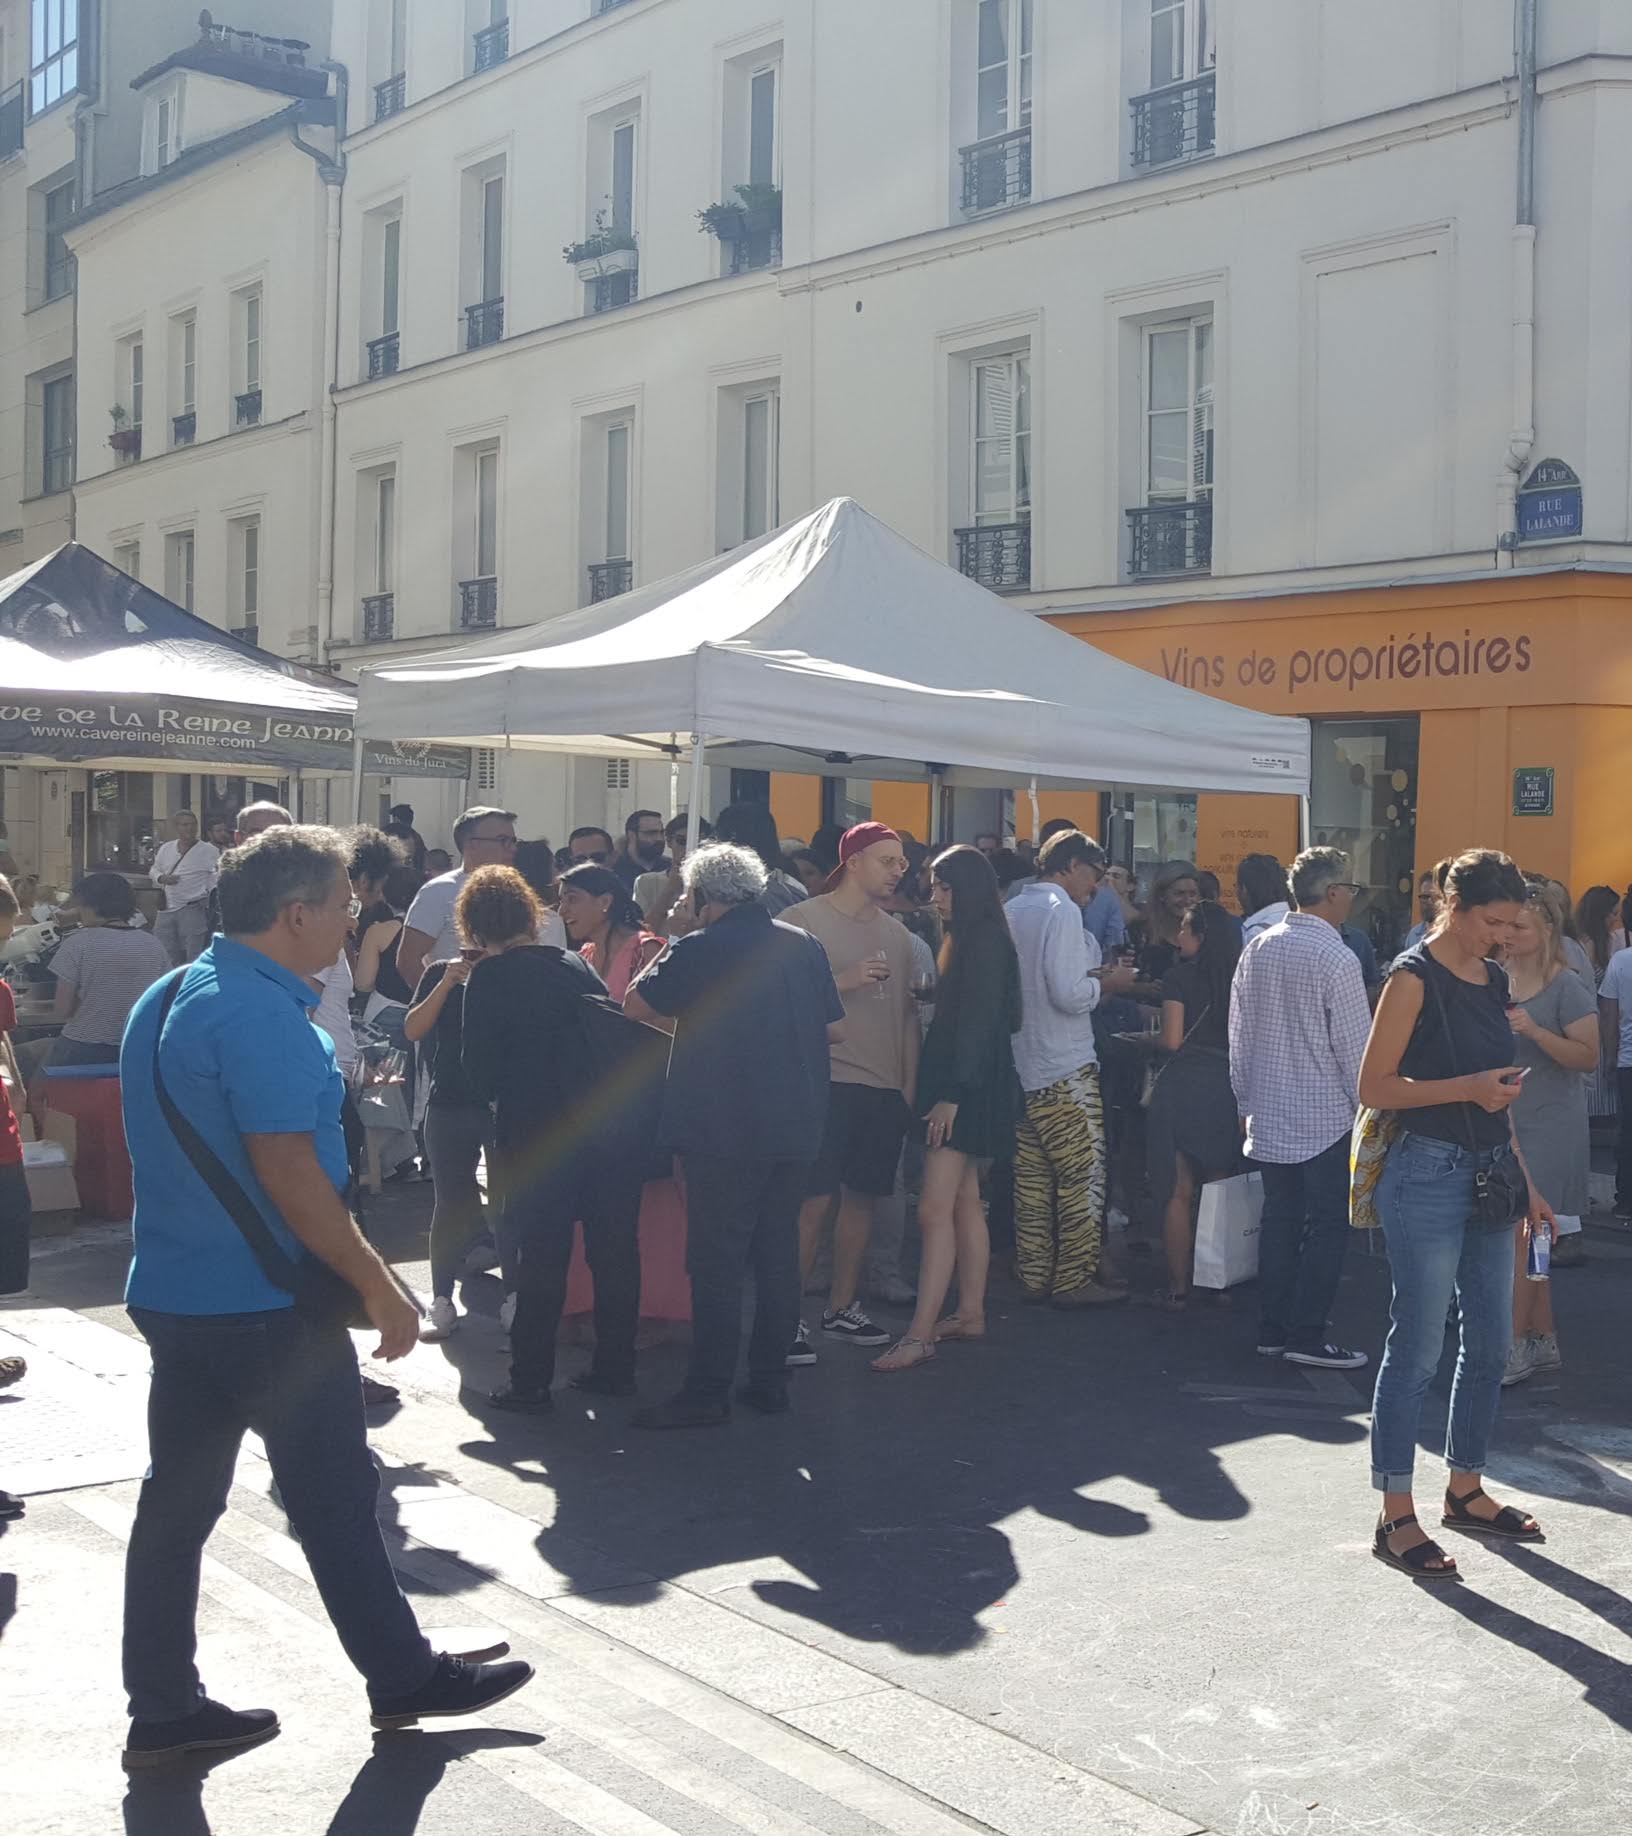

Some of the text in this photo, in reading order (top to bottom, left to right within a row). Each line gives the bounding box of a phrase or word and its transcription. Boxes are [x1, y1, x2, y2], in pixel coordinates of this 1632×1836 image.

[1538, 498, 1562, 513] RUE
[1526, 513, 1574, 531] LALANDE
[1160, 628, 1531, 694] Vins de propriétaires
[56, 707, 97, 725] de
[259, 717, 354, 744] Jeann
[31, 726, 256, 750] www.cavereinejeanne.com
[404, 755, 420, 766] du
